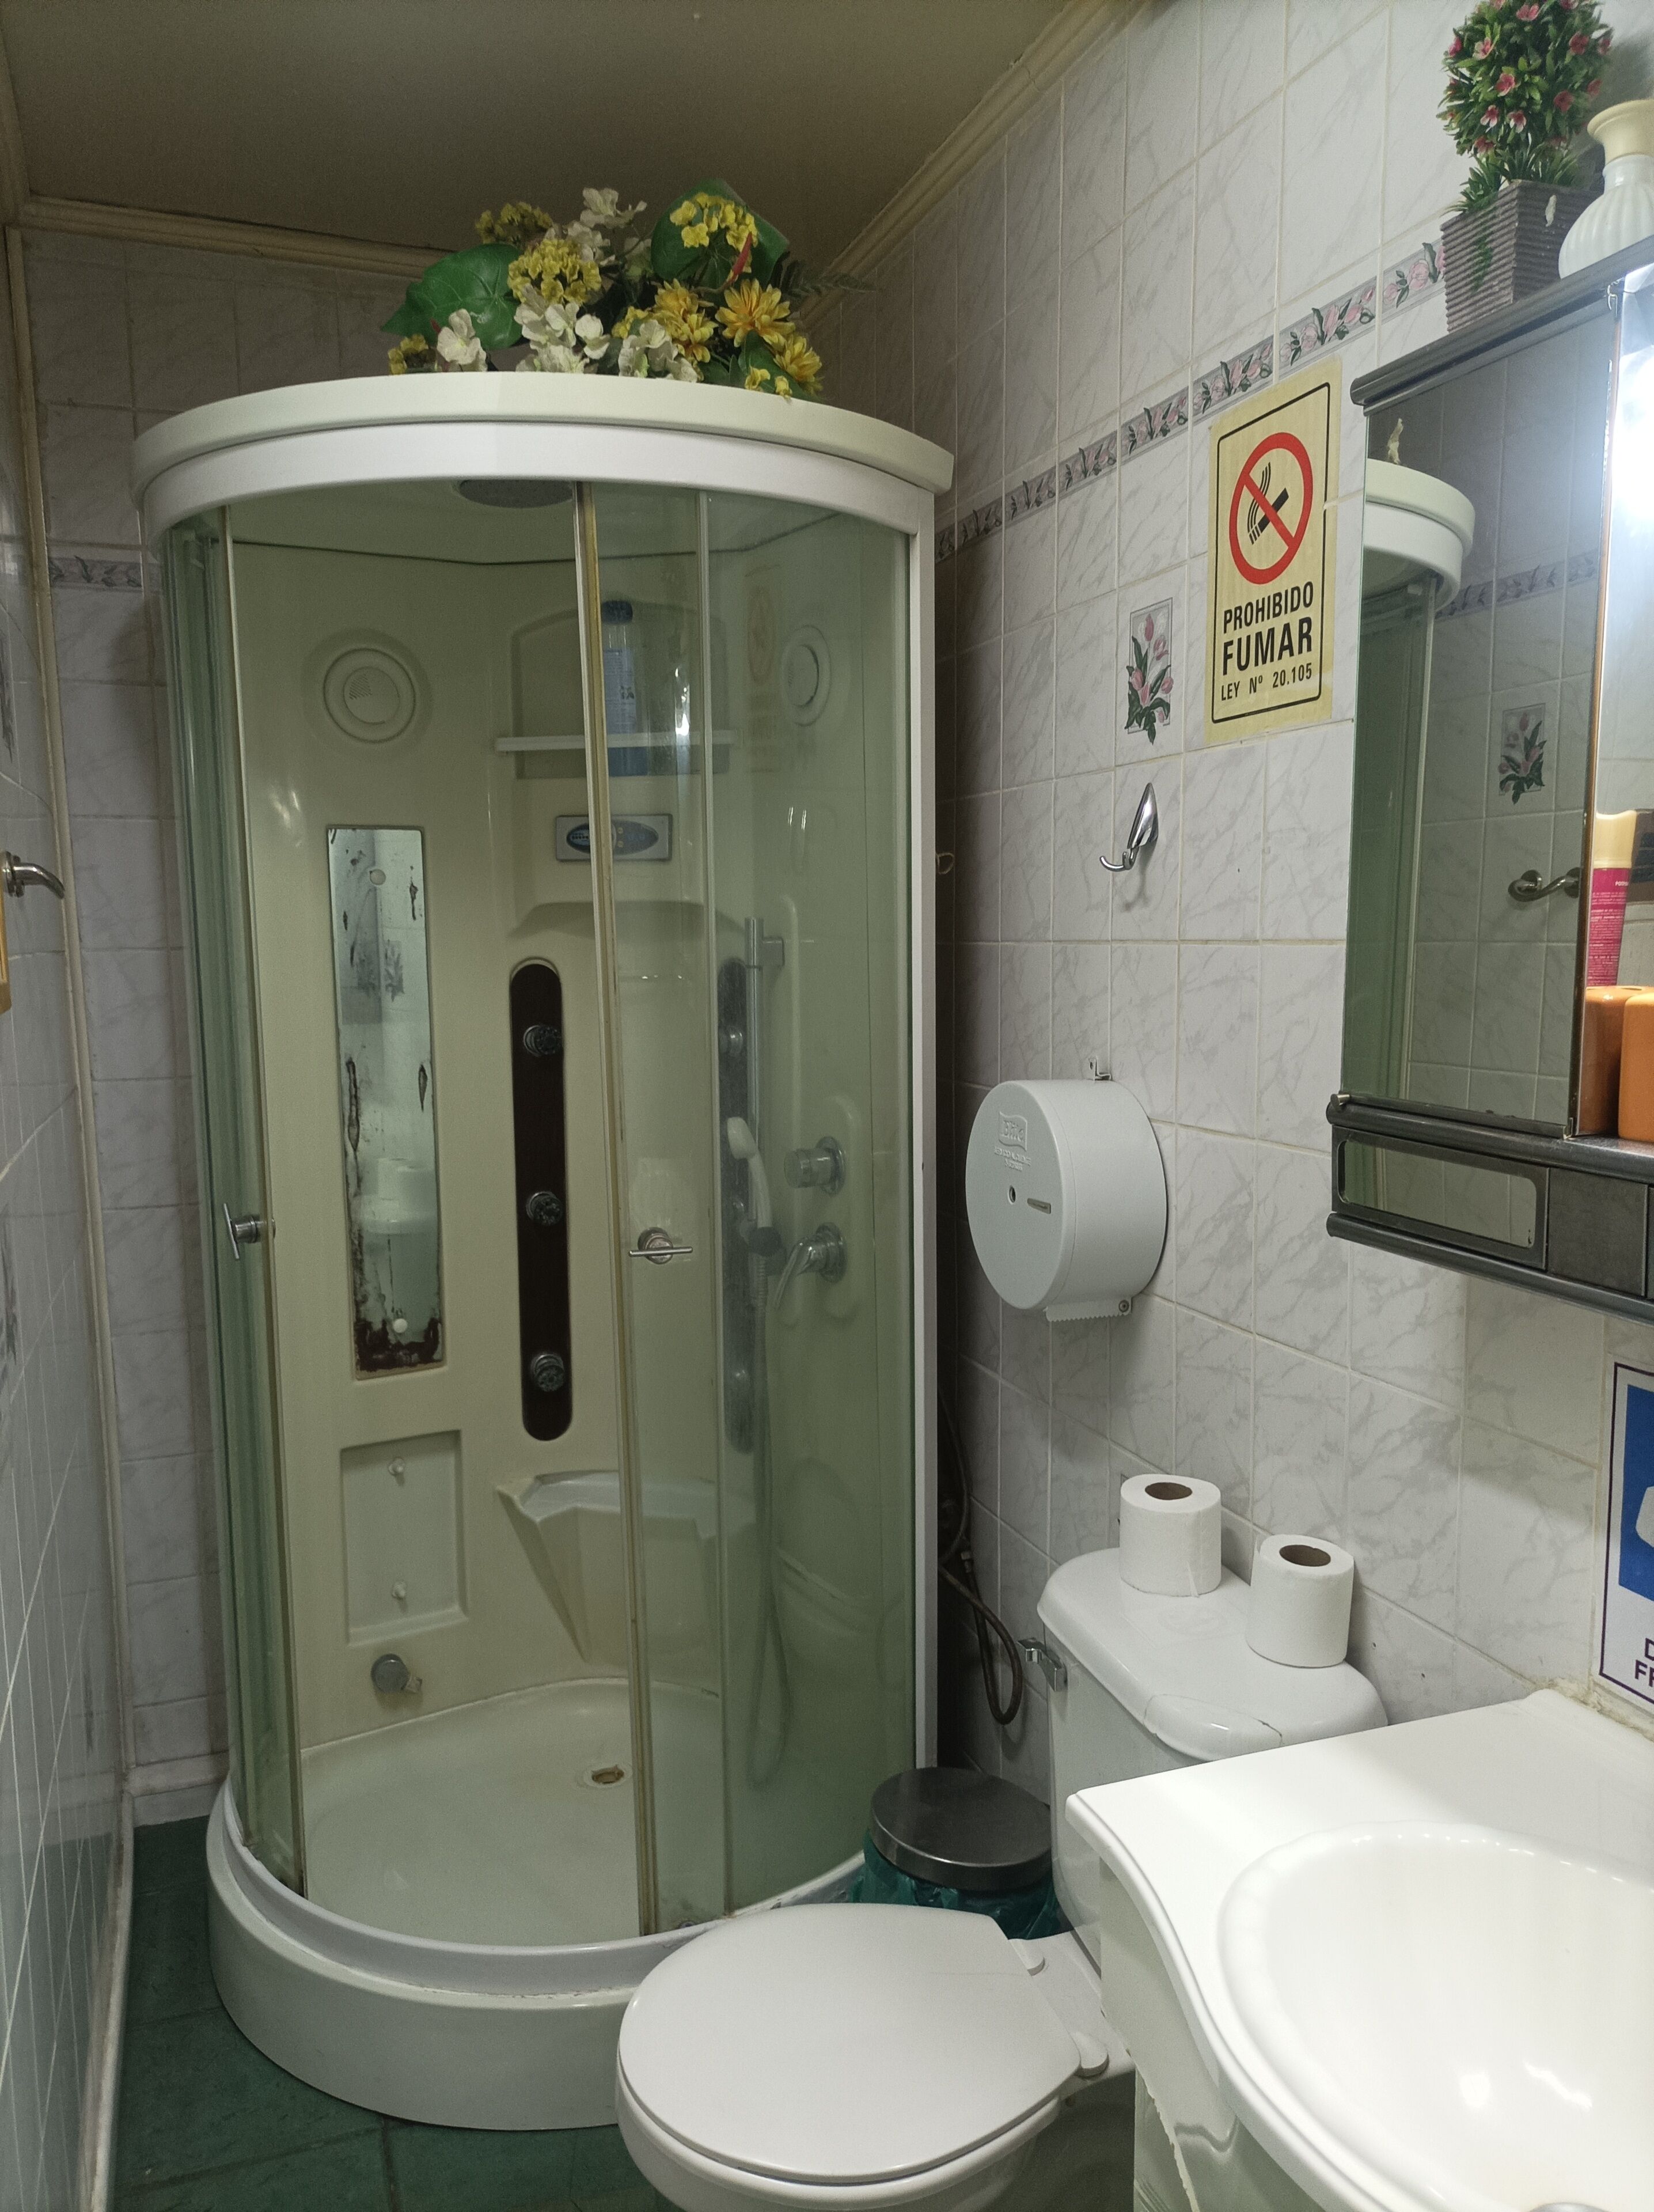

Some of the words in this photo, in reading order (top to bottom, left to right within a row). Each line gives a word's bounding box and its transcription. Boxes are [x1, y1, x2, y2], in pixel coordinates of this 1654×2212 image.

[1224, 581, 1313, 634] PROHIBIDO
[1223, 617, 1312, 676] FUMAR
[1221, 681, 1240, 701] LEY
[1273, 662, 1312, 688] 20.105
